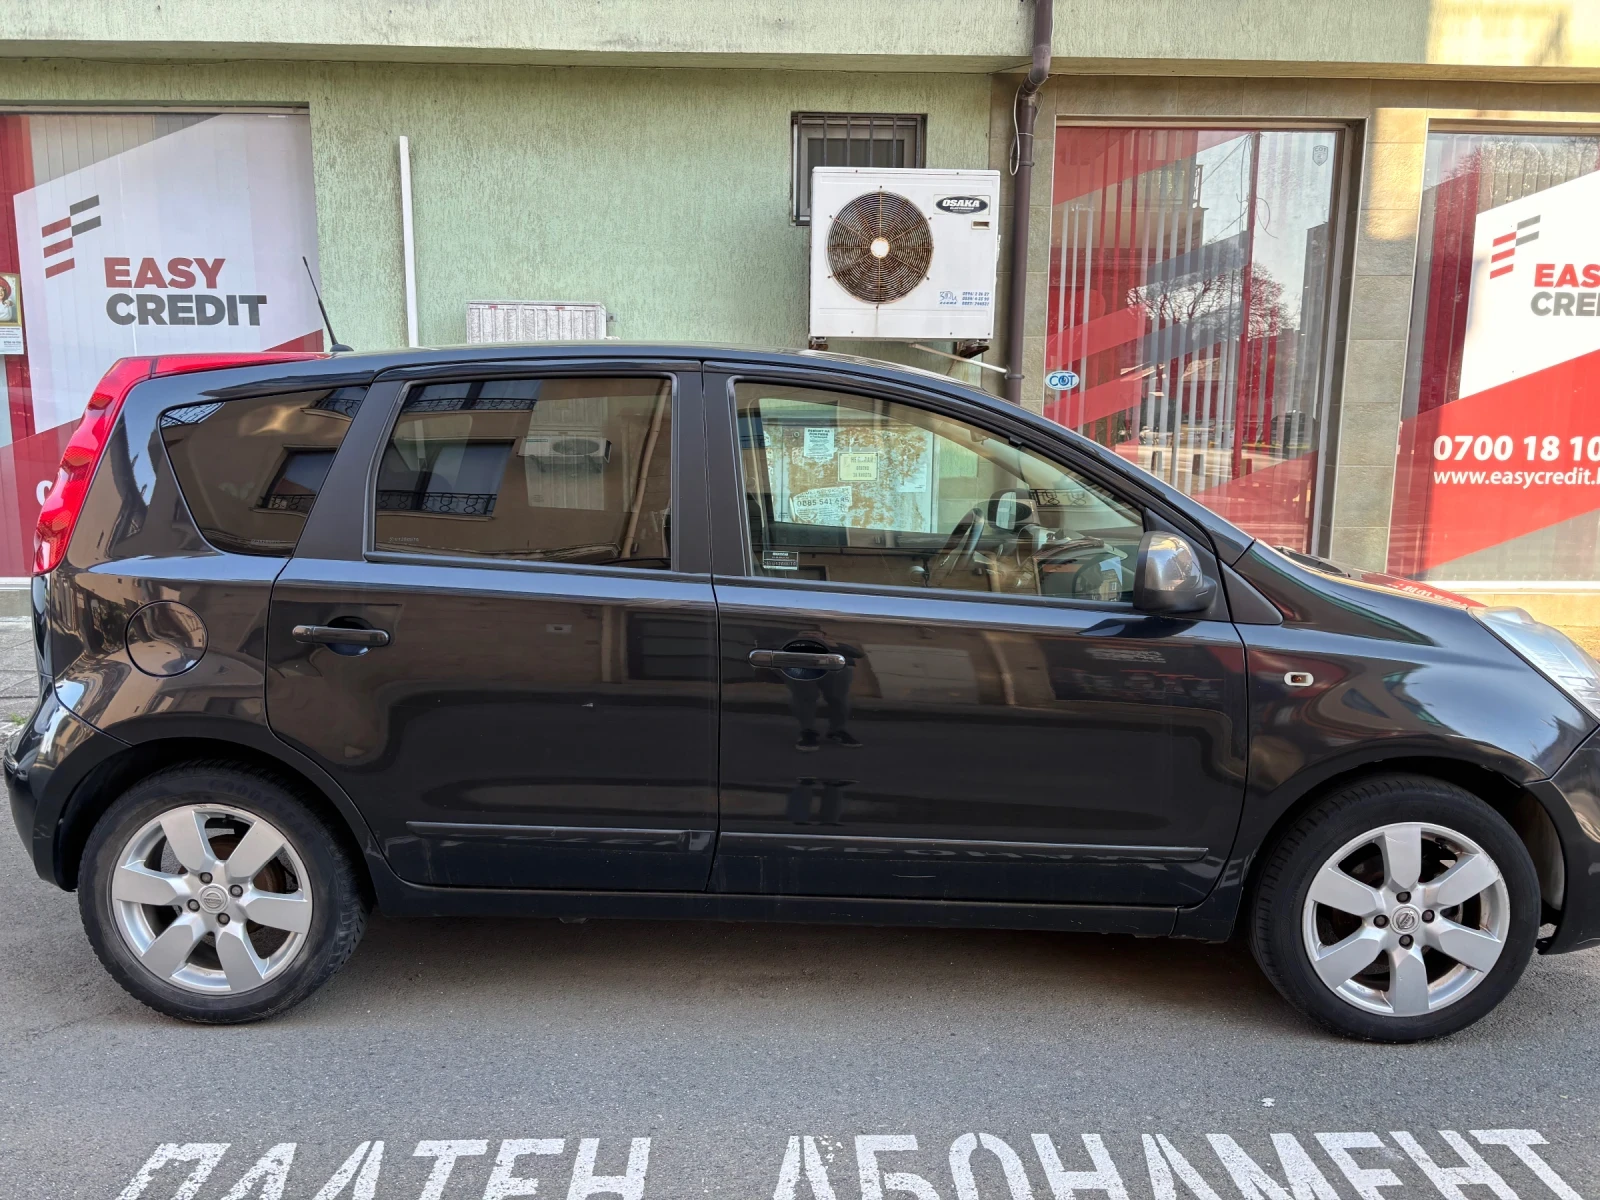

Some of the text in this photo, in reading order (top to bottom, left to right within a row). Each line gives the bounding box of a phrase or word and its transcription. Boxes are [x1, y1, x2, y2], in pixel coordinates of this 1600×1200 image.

[942, 199, 980, 207] OSAKA
[104, 257, 226, 289] EASY
[1534, 264, 1600, 288] EAS
[106, 293, 267, 326] CREDIT
[1530, 291, 1600, 317] CRE
[1433, 435, 1600, 462] 0700 18 10
